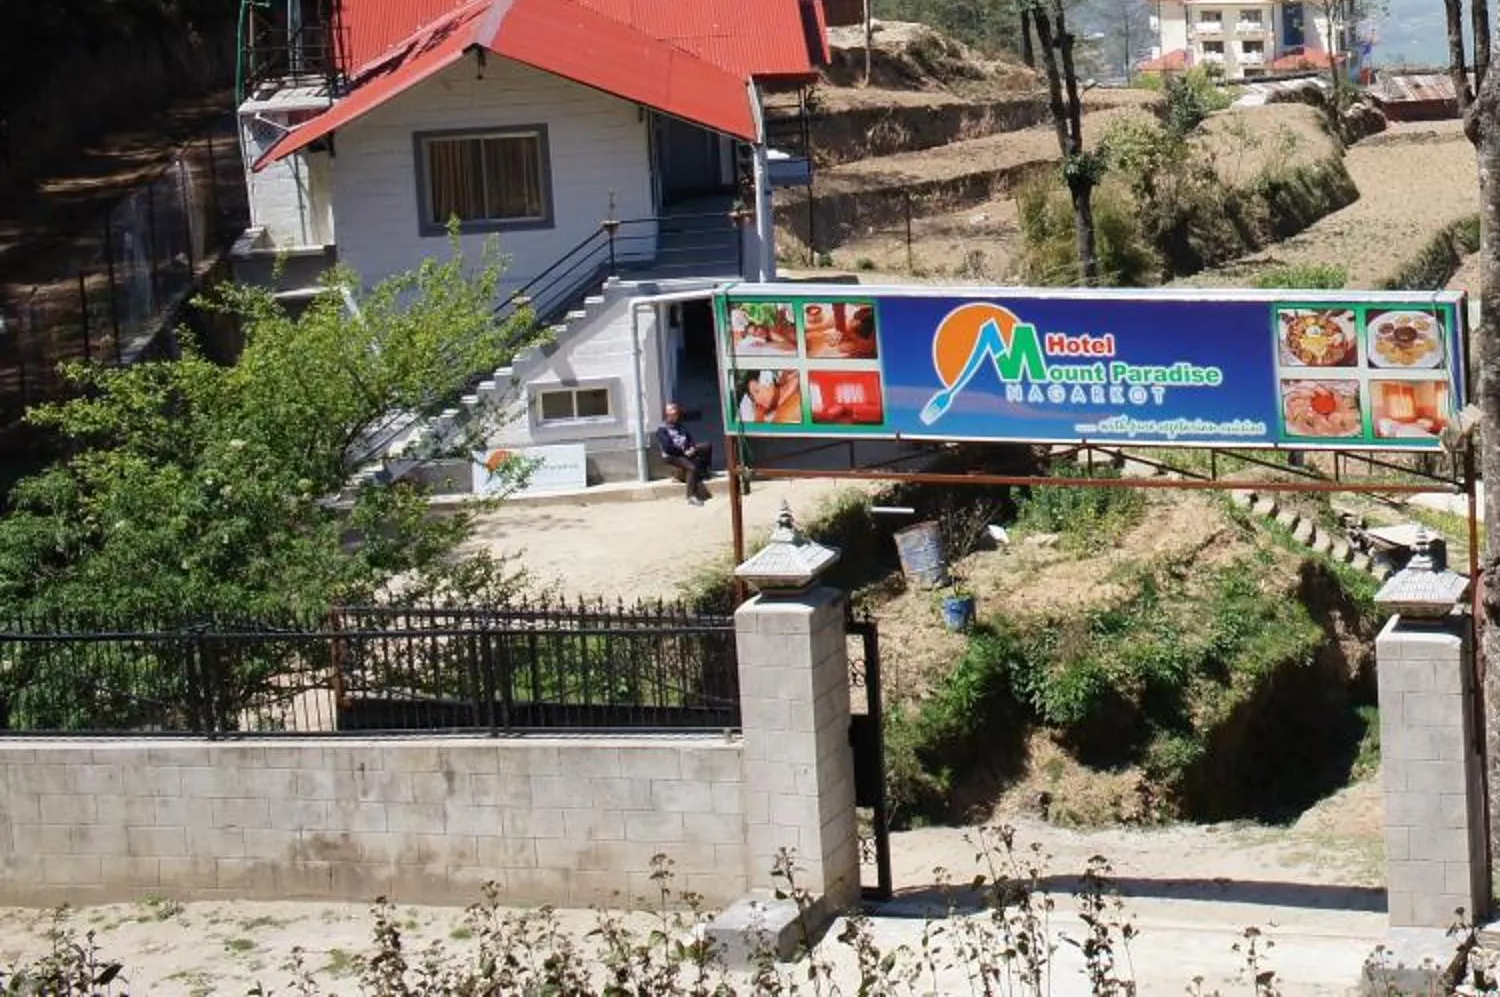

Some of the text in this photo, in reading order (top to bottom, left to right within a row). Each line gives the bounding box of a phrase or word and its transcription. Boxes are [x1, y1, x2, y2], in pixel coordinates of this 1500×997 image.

[992, 323, 1222, 385] Mount Paradise
[1046, 332, 1115, 355] Hotel
[1006, 383, 1166, 405] NAGARKOT
